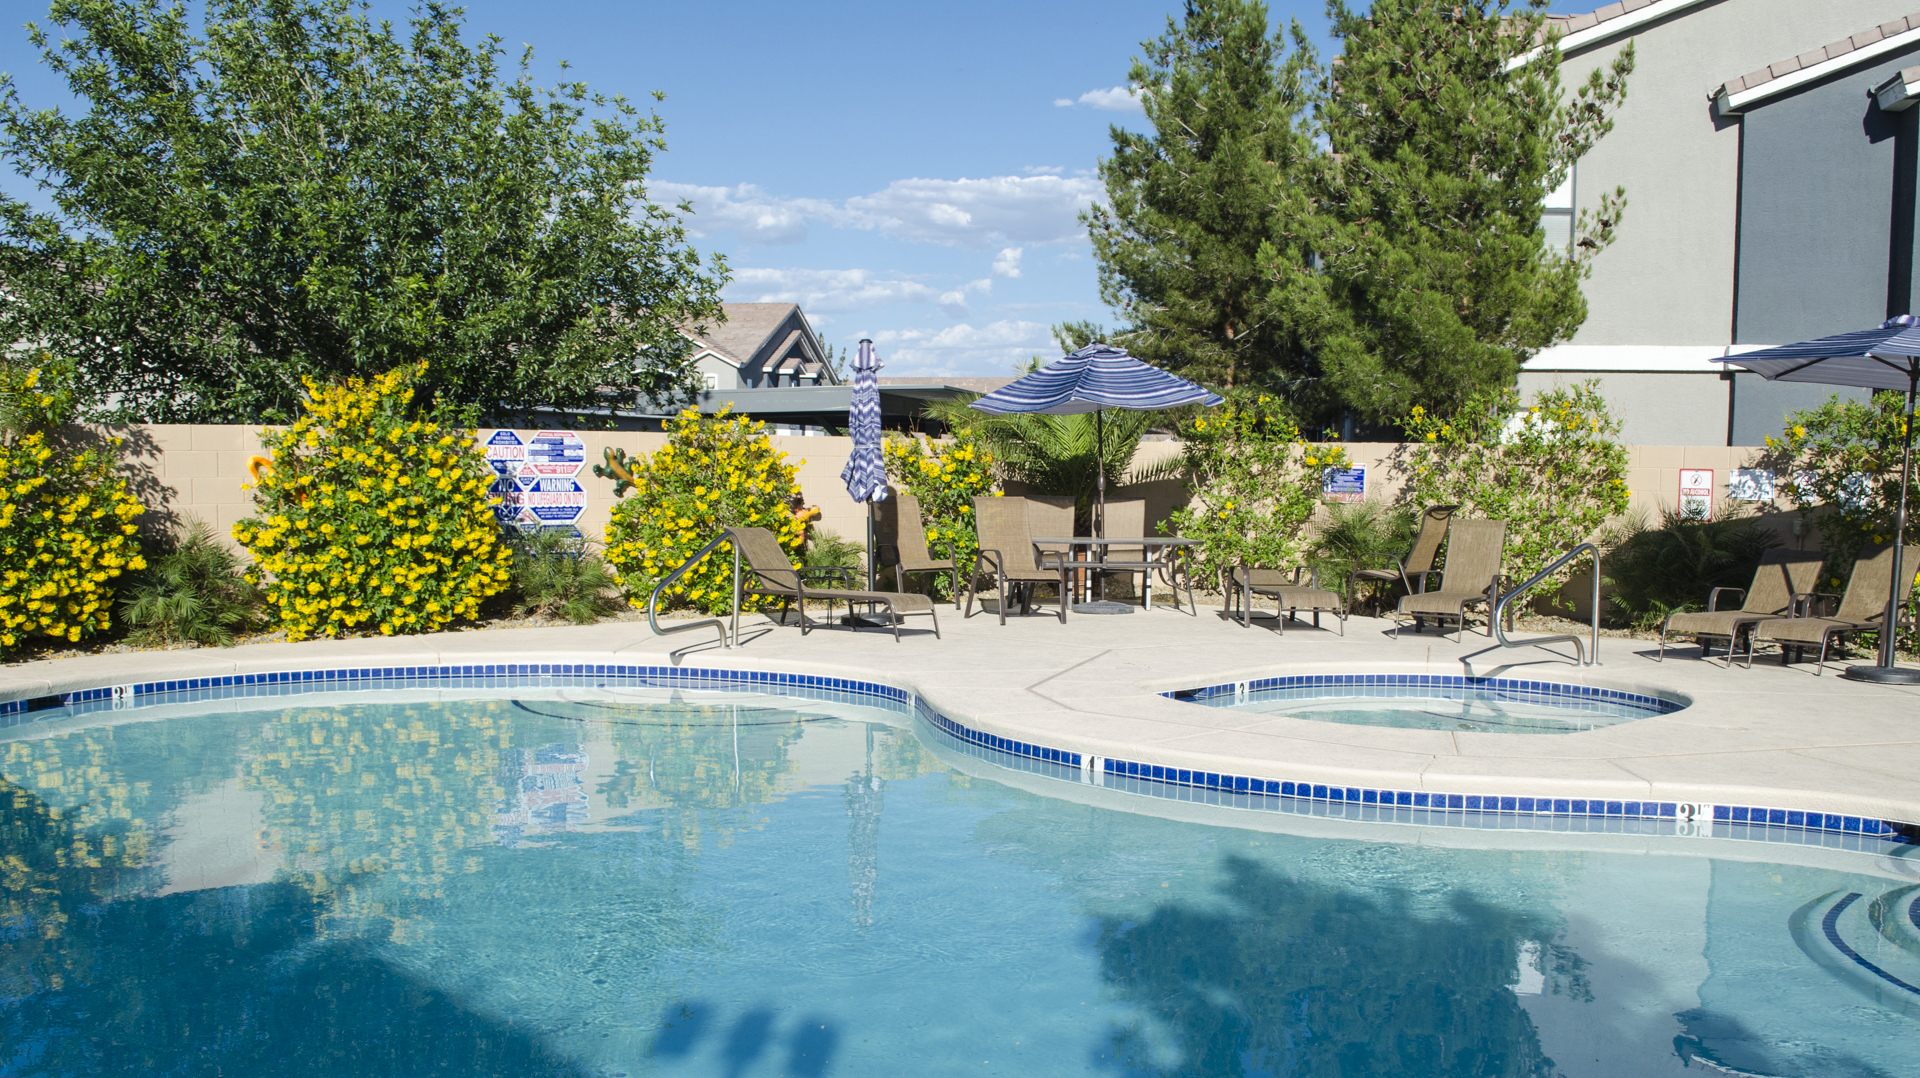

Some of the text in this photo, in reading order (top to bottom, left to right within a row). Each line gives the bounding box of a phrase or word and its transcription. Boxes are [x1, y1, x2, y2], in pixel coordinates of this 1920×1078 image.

[487, 446, 525, 459] CAUTION
[499, 479, 514, 492] NO
[539, 478, 575, 492] WARNING
[528, 493, 585, 505] NO LIFEGUARD ON DUTY
